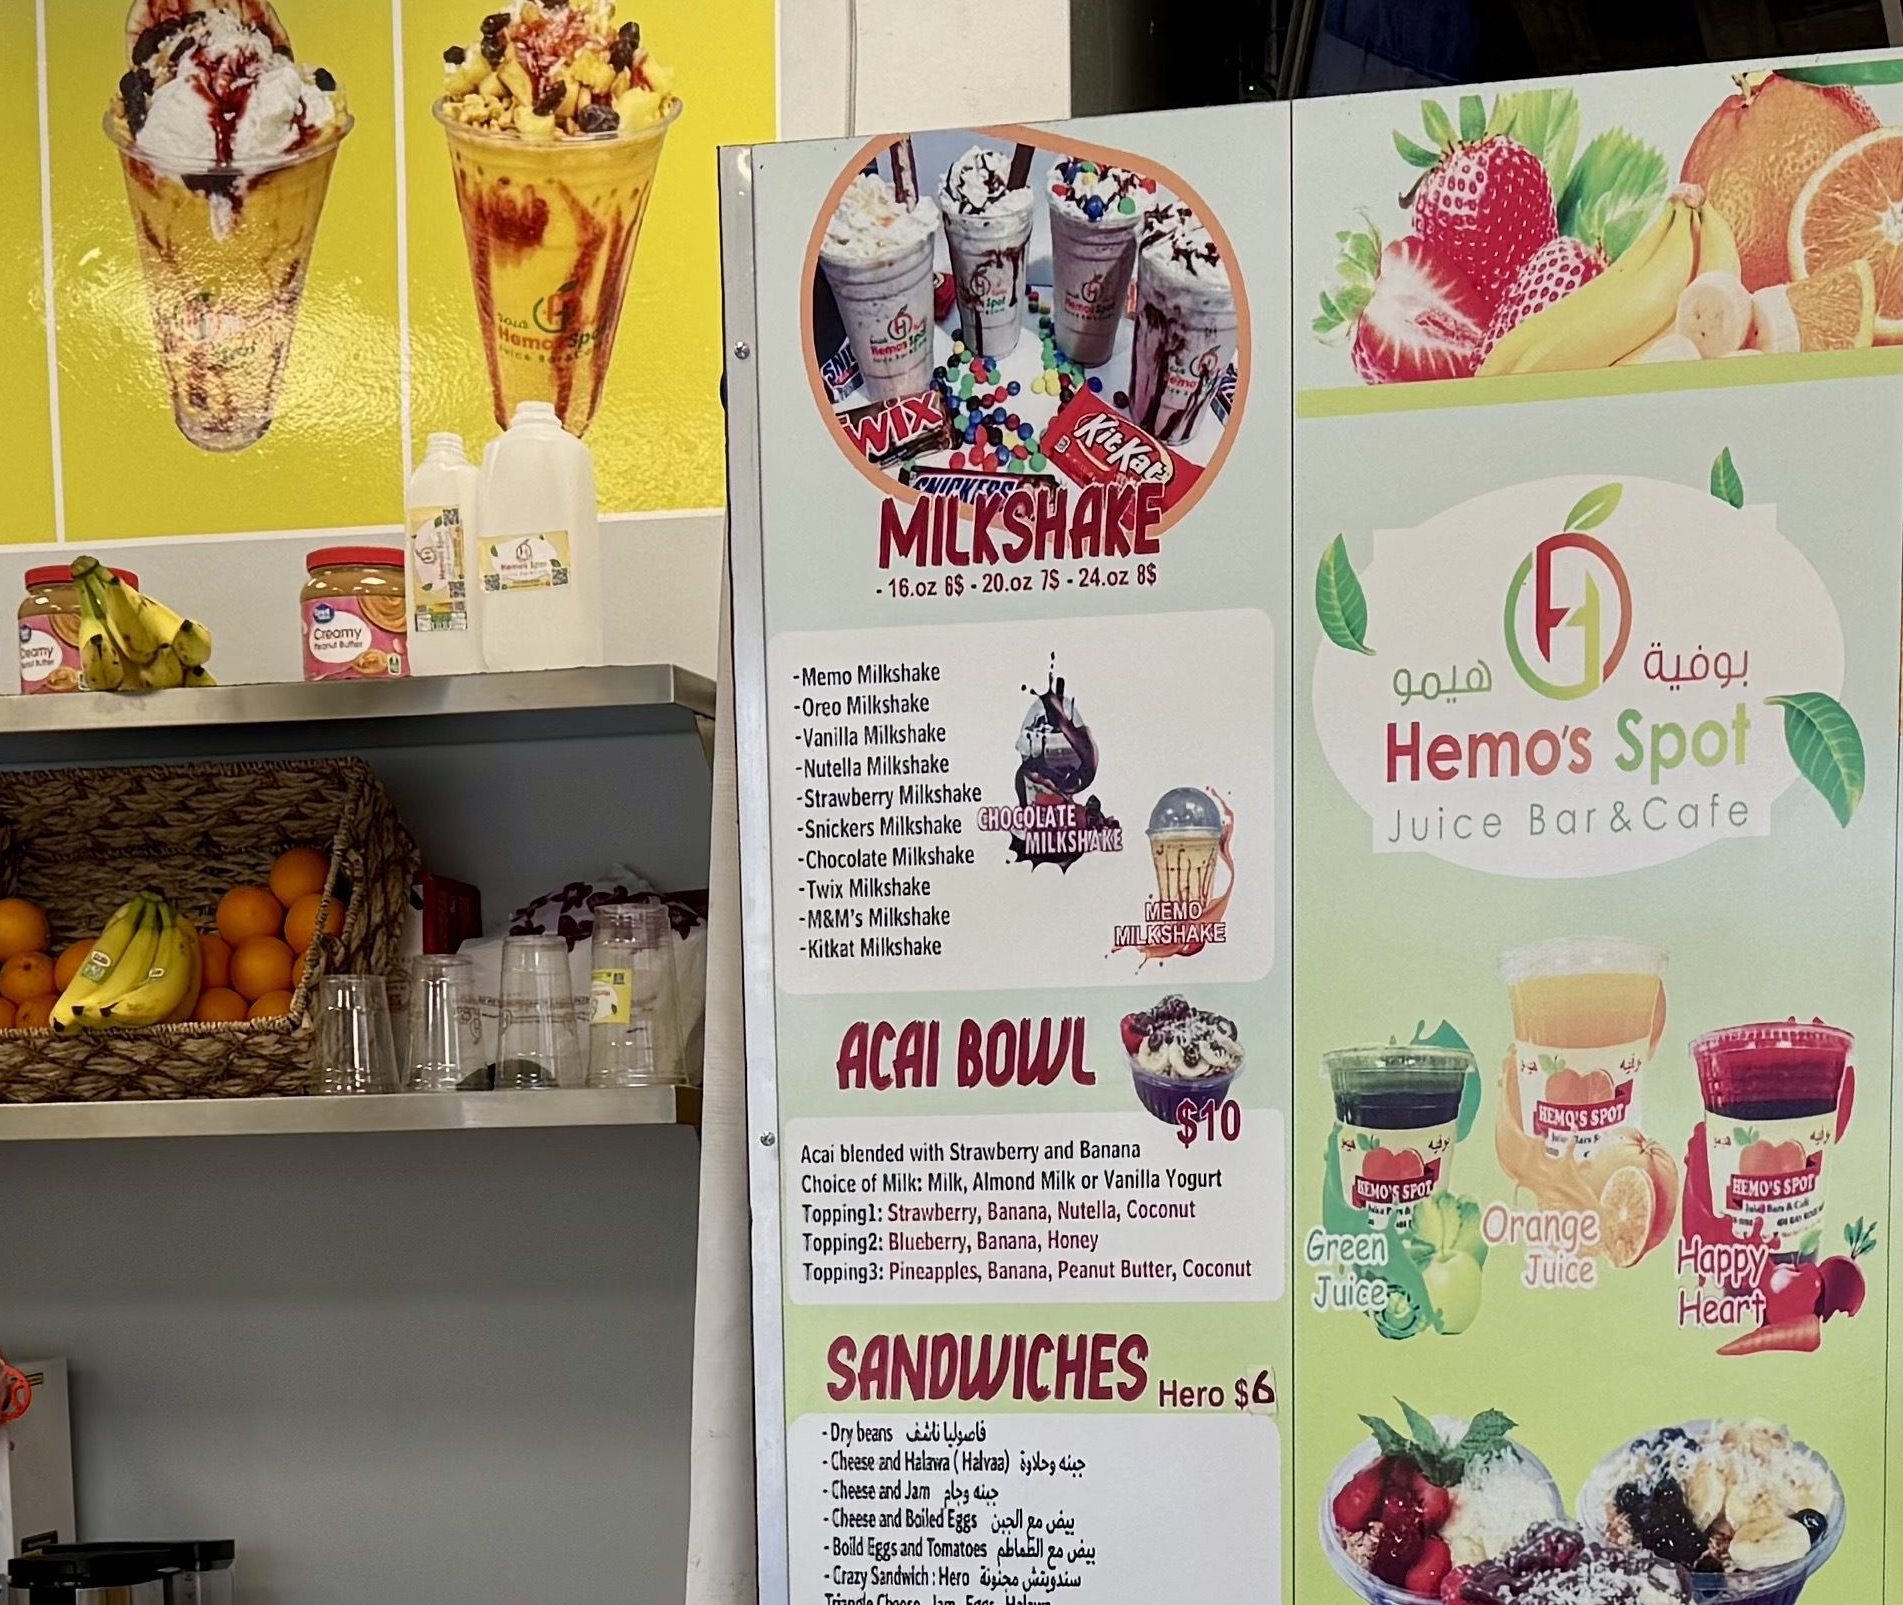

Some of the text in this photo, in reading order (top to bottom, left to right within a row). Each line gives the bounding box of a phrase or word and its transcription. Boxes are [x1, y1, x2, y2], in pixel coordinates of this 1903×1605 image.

[879, 483, 1166, 568] MILKSHAKE
[314, 627, 362, 641] Creamy
[1392, 640, 1749, 706] بوفية هيمو
[1385, 701, 1751, 784] Hemo's Spot
[977, 804, 1077, 831] CHOCOLATE
[1386, 806, 1503, 843] Juice
[1025, 828, 1123, 855] MILKSHAKE
[1145, 901, 1202, 921] MEMO
[1115, 923, 1226, 944] MILKSHAKE
[836, 1016, 1097, 1091] ACAI BOWL
[1176, 1098, 1241, 1149] $10
[801, 1139, 1141, 1164] Acai blended with Strawberry and Banana
[1780, 1173, 1816, 1195] SPOT
[1482, 1206, 1599, 1248] Orange
[1306, 1229, 1387, 1264] Green
[1678, 1237, 1767, 1283] Happy
[1524, 1256, 1596, 1286] Juice
[1312, 1278, 1387, 1309] Juice
[1678, 1291, 1766, 1326] Heart
[826, 1332, 1150, 1402] SANDWICHES
[1158, 1380, 1225, 1409] Hero
[830, 1424, 853, 1444] Dry
[856, 1424, 894, 1443] beans
